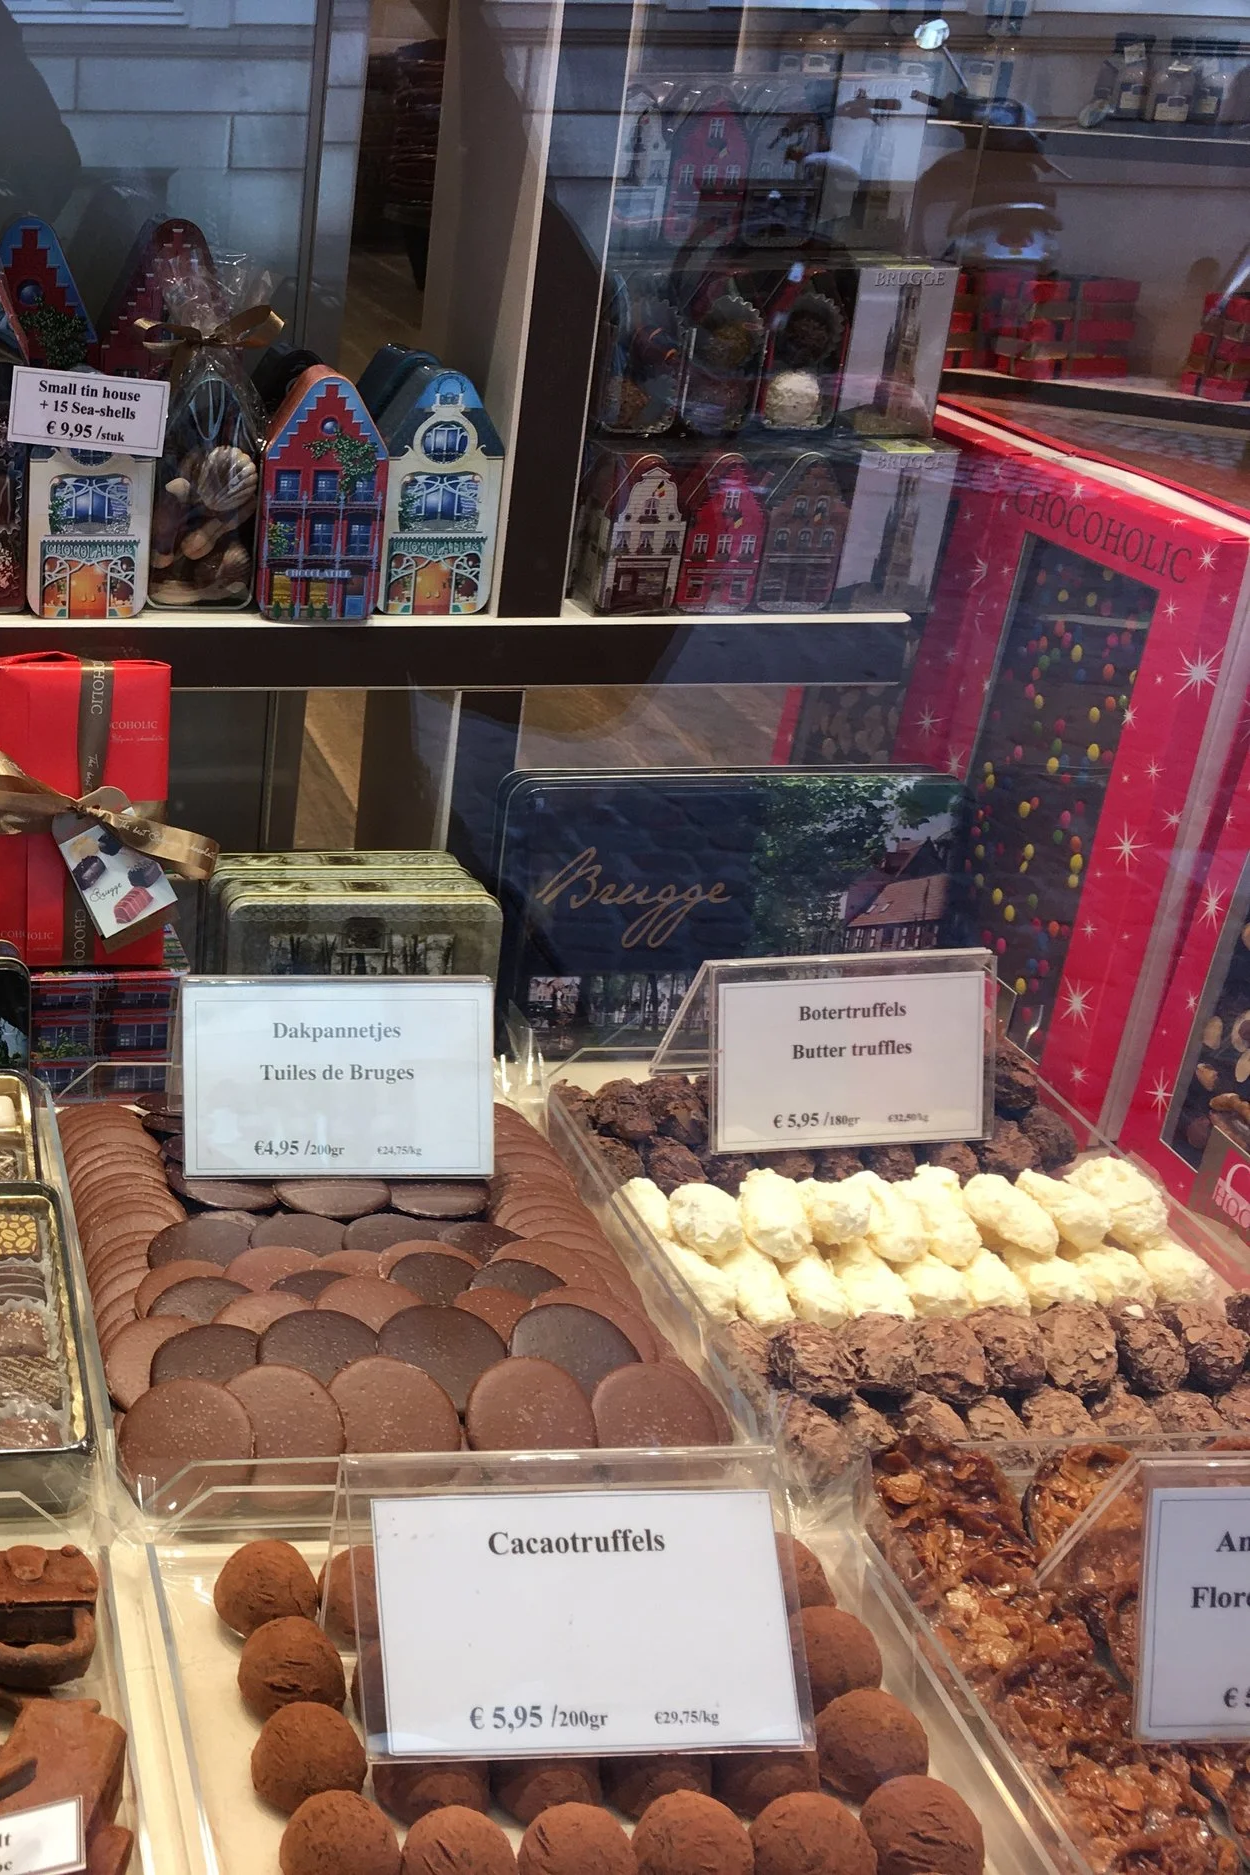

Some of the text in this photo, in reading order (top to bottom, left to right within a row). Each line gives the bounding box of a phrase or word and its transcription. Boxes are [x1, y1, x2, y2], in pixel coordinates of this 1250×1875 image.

[874, 270, 946, 287] BRUGGE
[39, 380, 141, 402] Small tin house
[40, 400, 136, 420] + 15 Sea-shells
[47, 421, 125, 442] € 9,95 /stuk
[876, 455, 945, 470] BRUGGE
[1014, 482, 1192, 583] CHOCOHOLIC
[47, 544, 138, 559] CHOCOLATIER
[397, 541, 485, 556] CHOCOLATIER
[89, 882, 123, 902] Brugge
[535, 846, 733, 949] Brugge
[799, 1002, 907, 1021] Botertruffels
[273, 1022, 401, 1042] Dakpannetjes
[792, 1040, 912, 1060] Butter truffles
[260, 1064, 414, 1084] Tuiles de Bruges
[773, 1114, 783, 1128] €
[787, 1112, 820, 1130] 5,95
[823, 1111, 860, 1127] /180gr
[254, 1140, 299, 1158] €4,95
[304, 1140, 345, 1158] /200gr
[488, 1529, 666, 1555] Cacaotruffels
[1223, 1687, 1239, 1708] €
[470, 1704, 720, 1734] € 5,95 /200gr €29,75/kg
